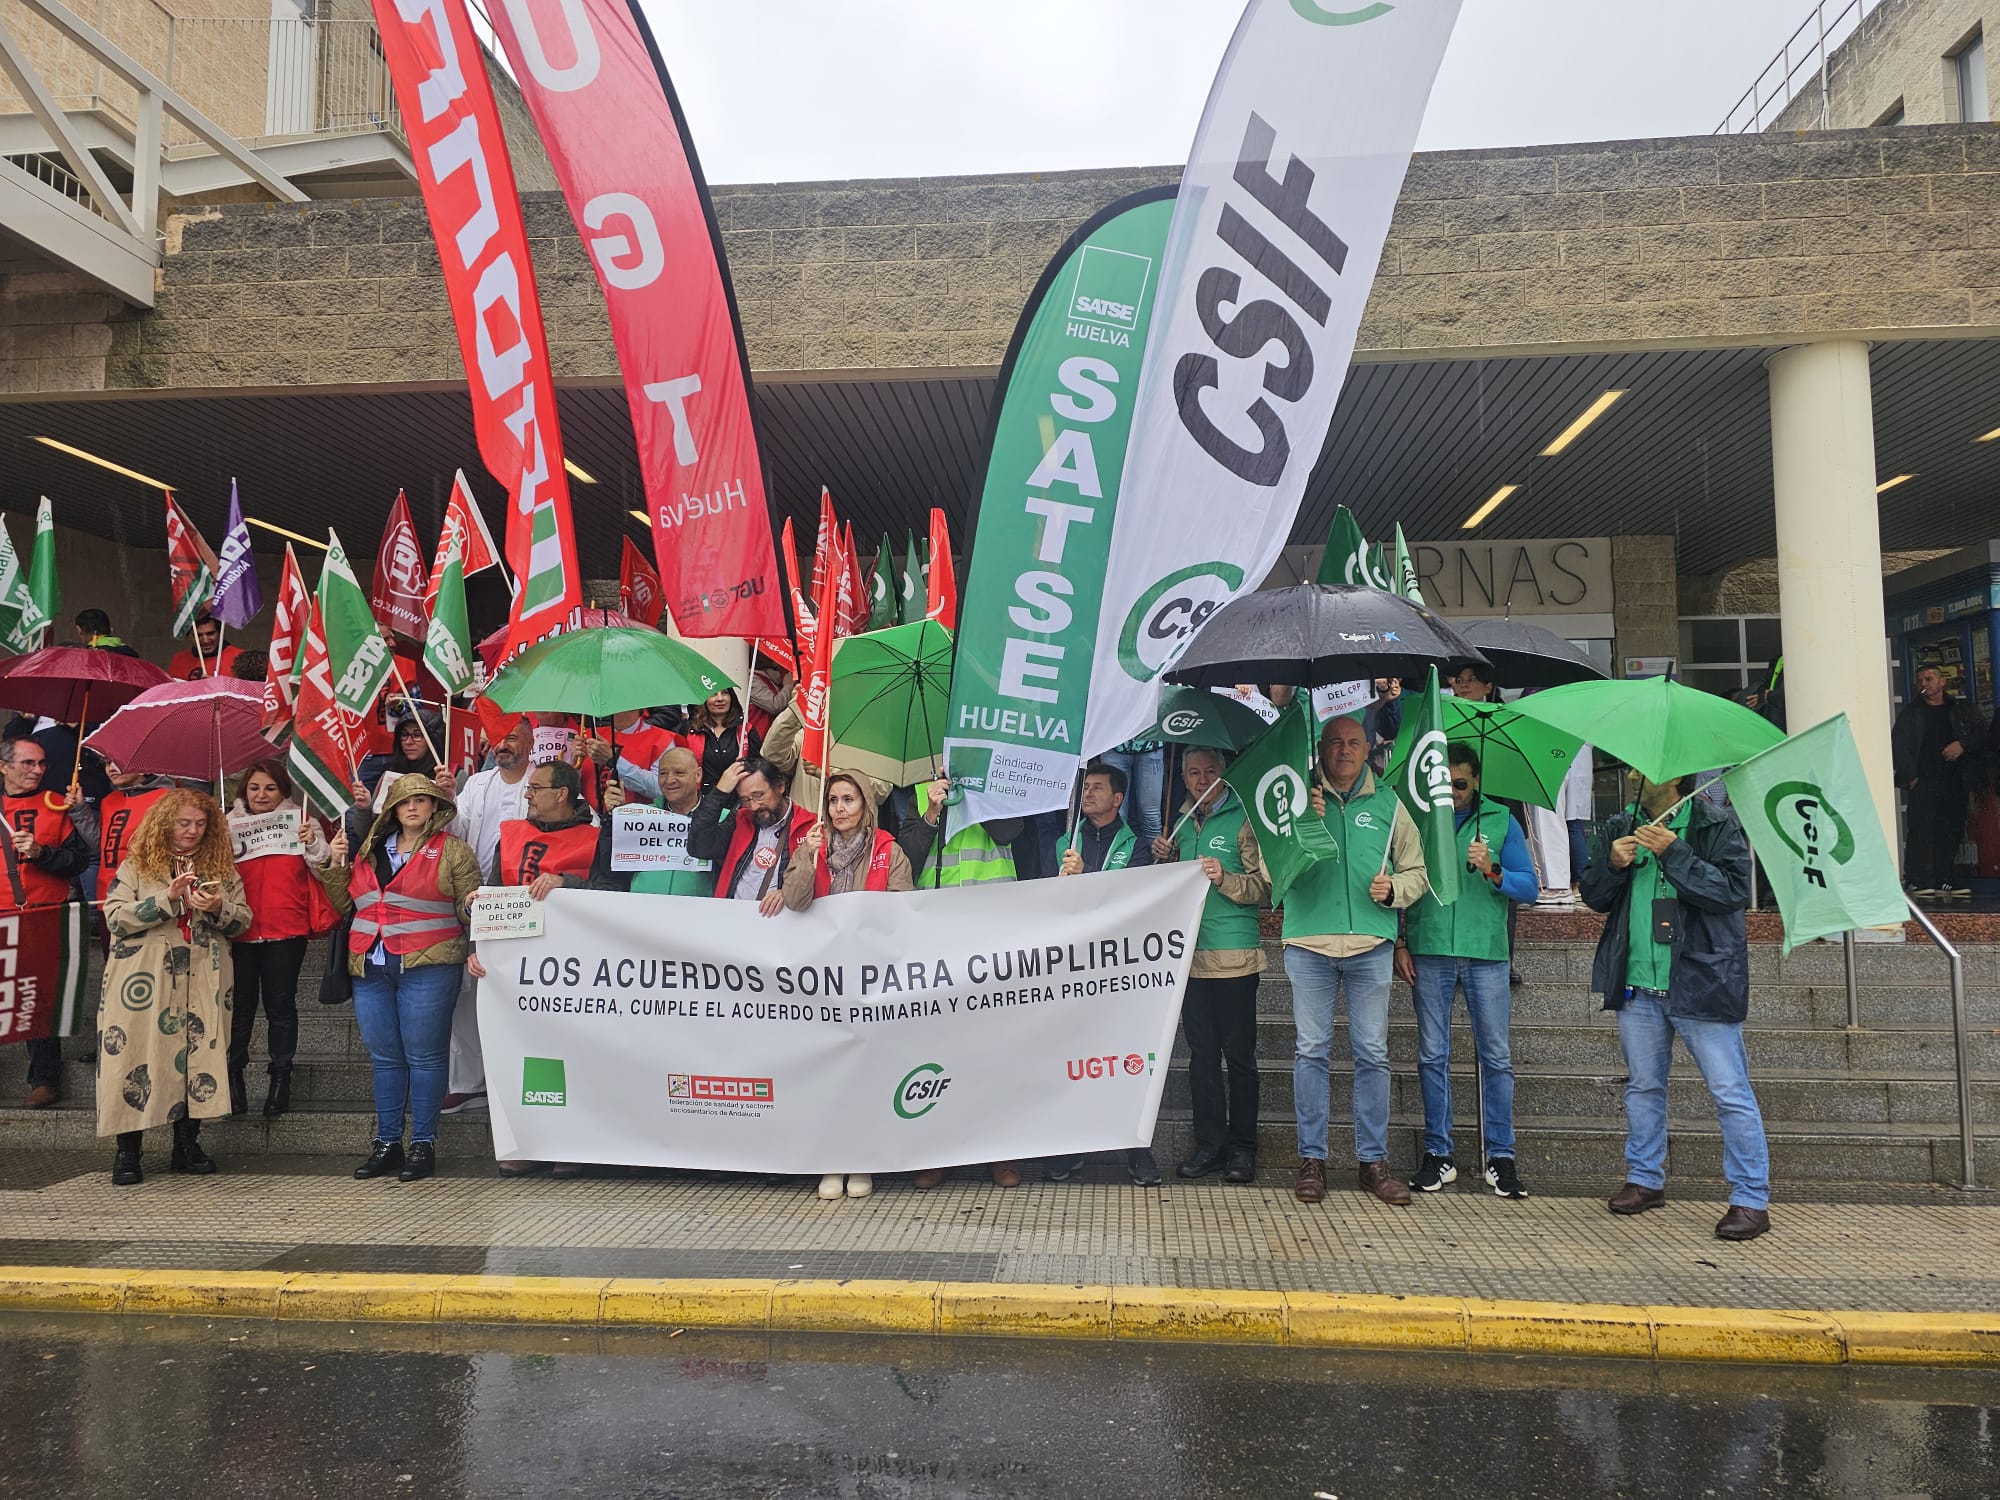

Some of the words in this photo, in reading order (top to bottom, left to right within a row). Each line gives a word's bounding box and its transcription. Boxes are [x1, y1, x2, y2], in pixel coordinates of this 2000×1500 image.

[1173, 109, 1349, 487] CSIF
[1076, 296, 1134, 322] SATSE
[1066, 322, 1131, 348] HUELVA
[998, 356, 1120, 704] SATSE
[1328, 692, 1346, 700] DEL
[1347, 684, 1361, 694] CRP
[1169, 716, 1204, 728] CSIF
[1254, 708, 1274, 719] OBO
[959, 705, 1070, 743] HUELVA
[994, 755, 1044, 772] Sindicato
[991, 768, 1004, 779] de
[989, 783, 1027, 798] Huelva
[1273, 781, 1292, 838] CSIF
[624, 822, 644, 832] NO
[648, 822, 664, 832] AL
[668, 823, 691, 832] RO
[250, 835, 265, 844] DEL
[640, 837, 662, 847] DEL
[507, 901, 531, 909] ROBO
[518, 957, 581, 987] LOS
[592, 959, 765, 993] ACUERDOS
[776, 966, 844, 997] SON
[860, 959, 955, 996] PARA
[967, 929, 1186, 984] CUMPLIRLOS
[518, 996, 623, 1017] CONSEJERA,
[630, 999, 699, 1017] CUMPLE
[706, 1001, 726, 1018] EL
[732, 1002, 814, 1022] ACUERDO
[821, 1006, 842, 1023] DE
[849, 1000, 942, 1024] PRIMARIA
[949, 998, 959, 1012] Y
[966, 988, 1054, 1012] CARRERA
[1066, 1055, 1119, 1081] UGT
[695, 1080, 754, 1097] CCOO
[904, 1078, 952, 1102] CSIF
[525, 1091, 564, 1104] SATSE
[669, 1098, 702, 1107] federación
